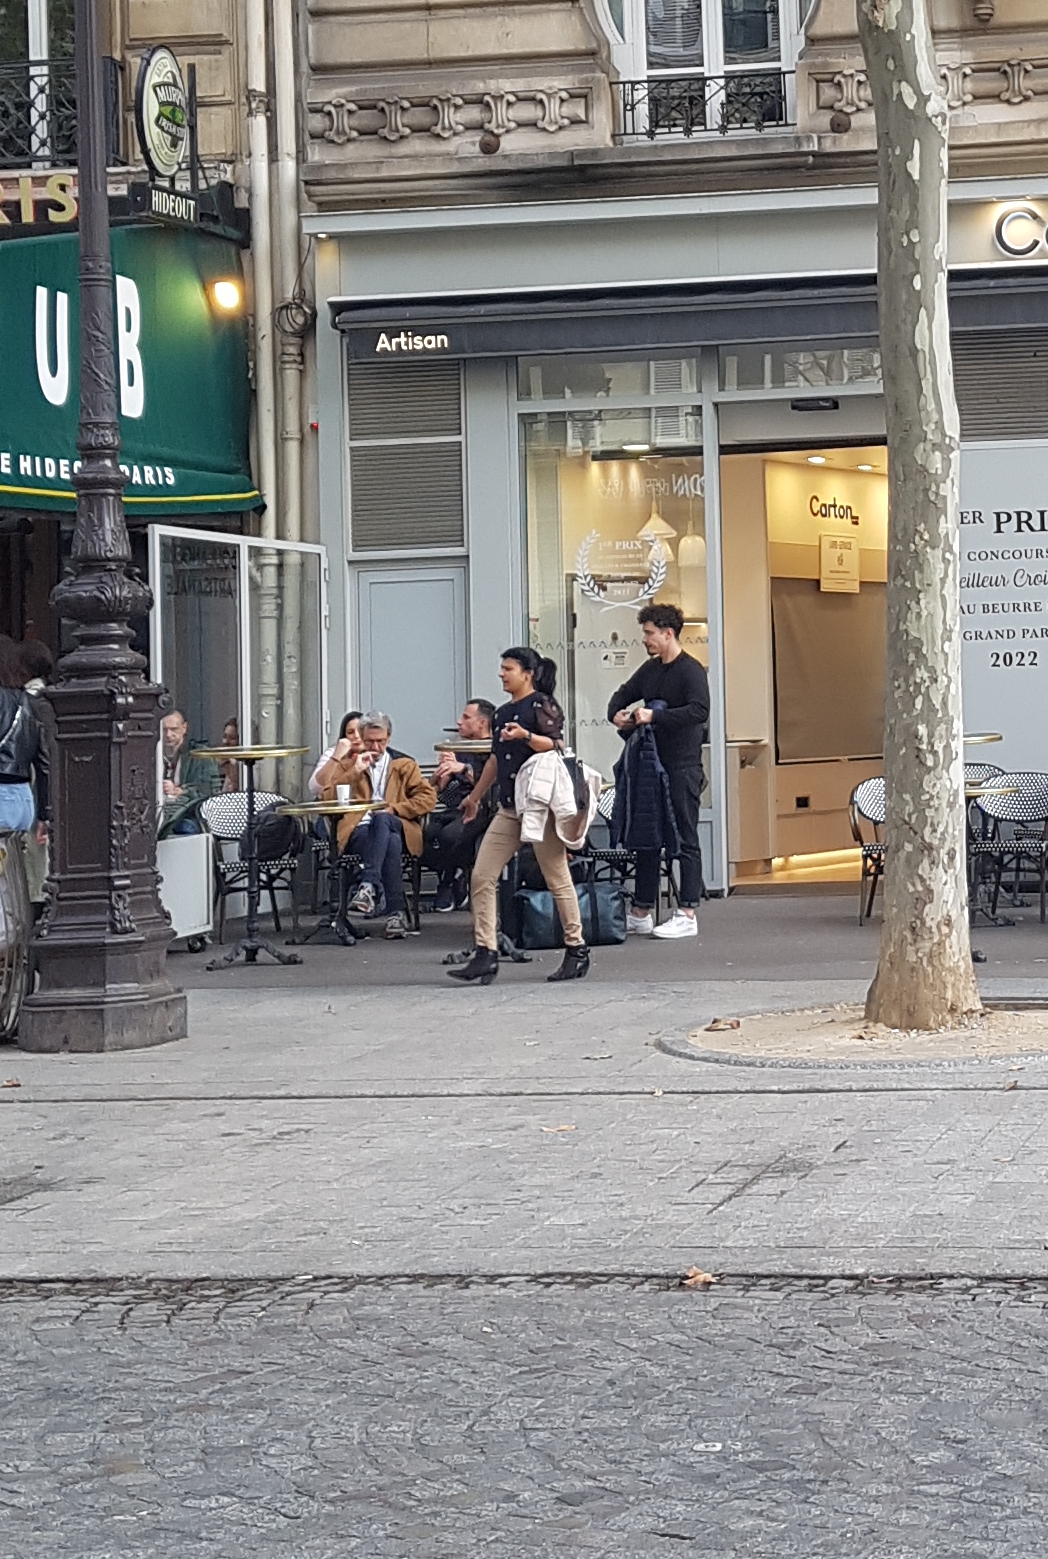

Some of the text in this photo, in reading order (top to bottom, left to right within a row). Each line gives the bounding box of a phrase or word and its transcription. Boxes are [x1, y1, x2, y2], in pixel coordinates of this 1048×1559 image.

[152, 190, 196, 221] HIDEOUT
[375, 331, 449, 352] Artisan
[809, 495, 859, 520] Carton
[615, 540, 643, 550] PRIX
[959, 572, 1009, 589] eilleur
[982, 601, 1043, 614] BEURRE
[963, 628, 1016, 641] GRAND
[990, 650, 1039, 668] 2022
